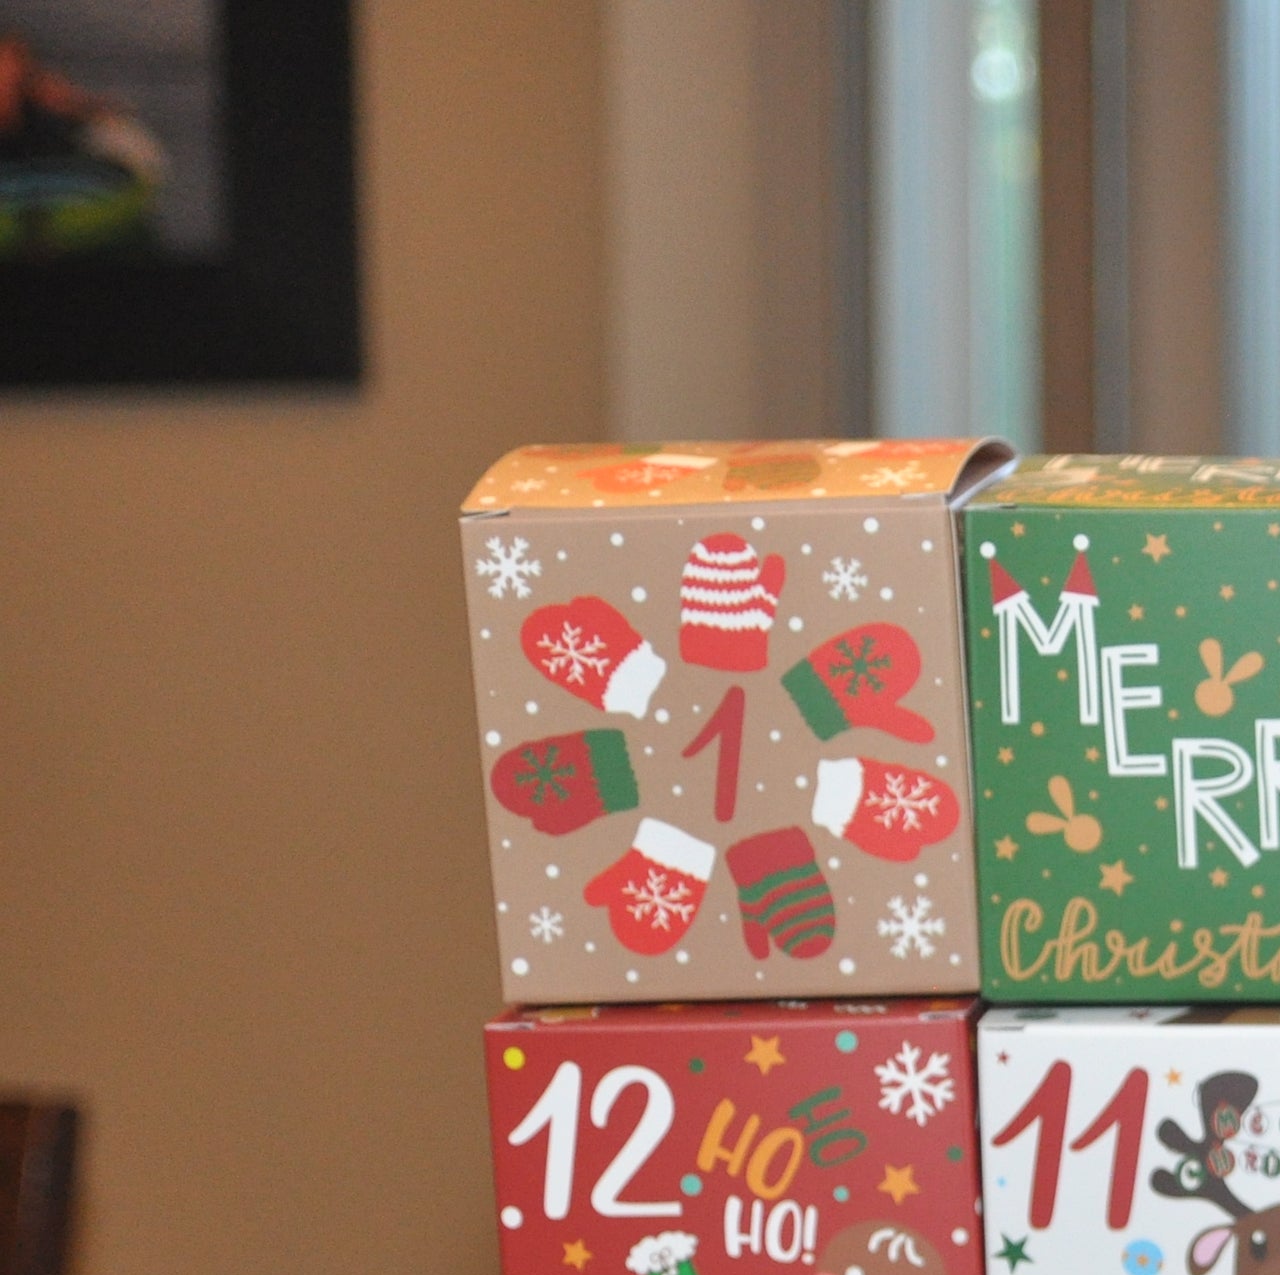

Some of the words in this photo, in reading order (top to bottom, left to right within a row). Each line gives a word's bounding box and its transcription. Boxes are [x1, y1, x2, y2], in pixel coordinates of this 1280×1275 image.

[682, 686, 746, 822] 1
[508, 1060, 683, 1219] 12
[697, 1098, 804, 1199] HO
[787, 1085, 868, 1168] HO
[991, 1057, 1151, 1231] 11
[724, 1195, 818, 1264] HO!
